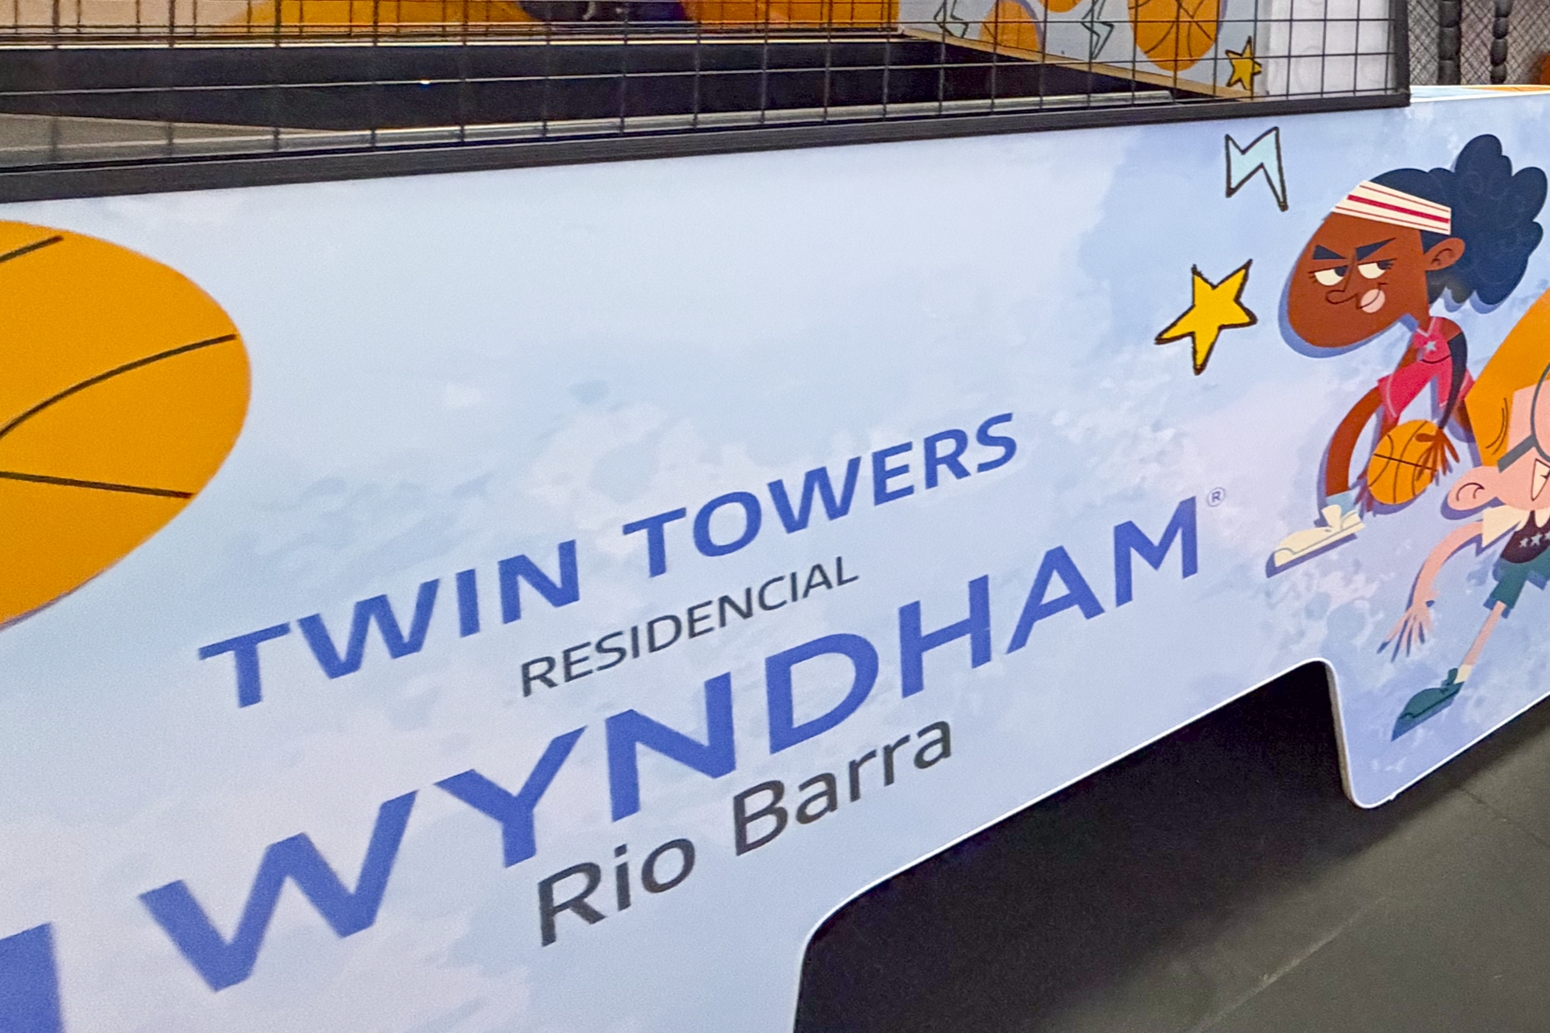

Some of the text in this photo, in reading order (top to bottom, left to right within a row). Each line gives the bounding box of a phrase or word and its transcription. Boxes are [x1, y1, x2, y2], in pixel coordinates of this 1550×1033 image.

[198, 411, 1019, 709] TWIN TOWERS
[518, 554, 861, 699] RESIDENCIAL
[536, 719, 954, 948] Rio Barra
